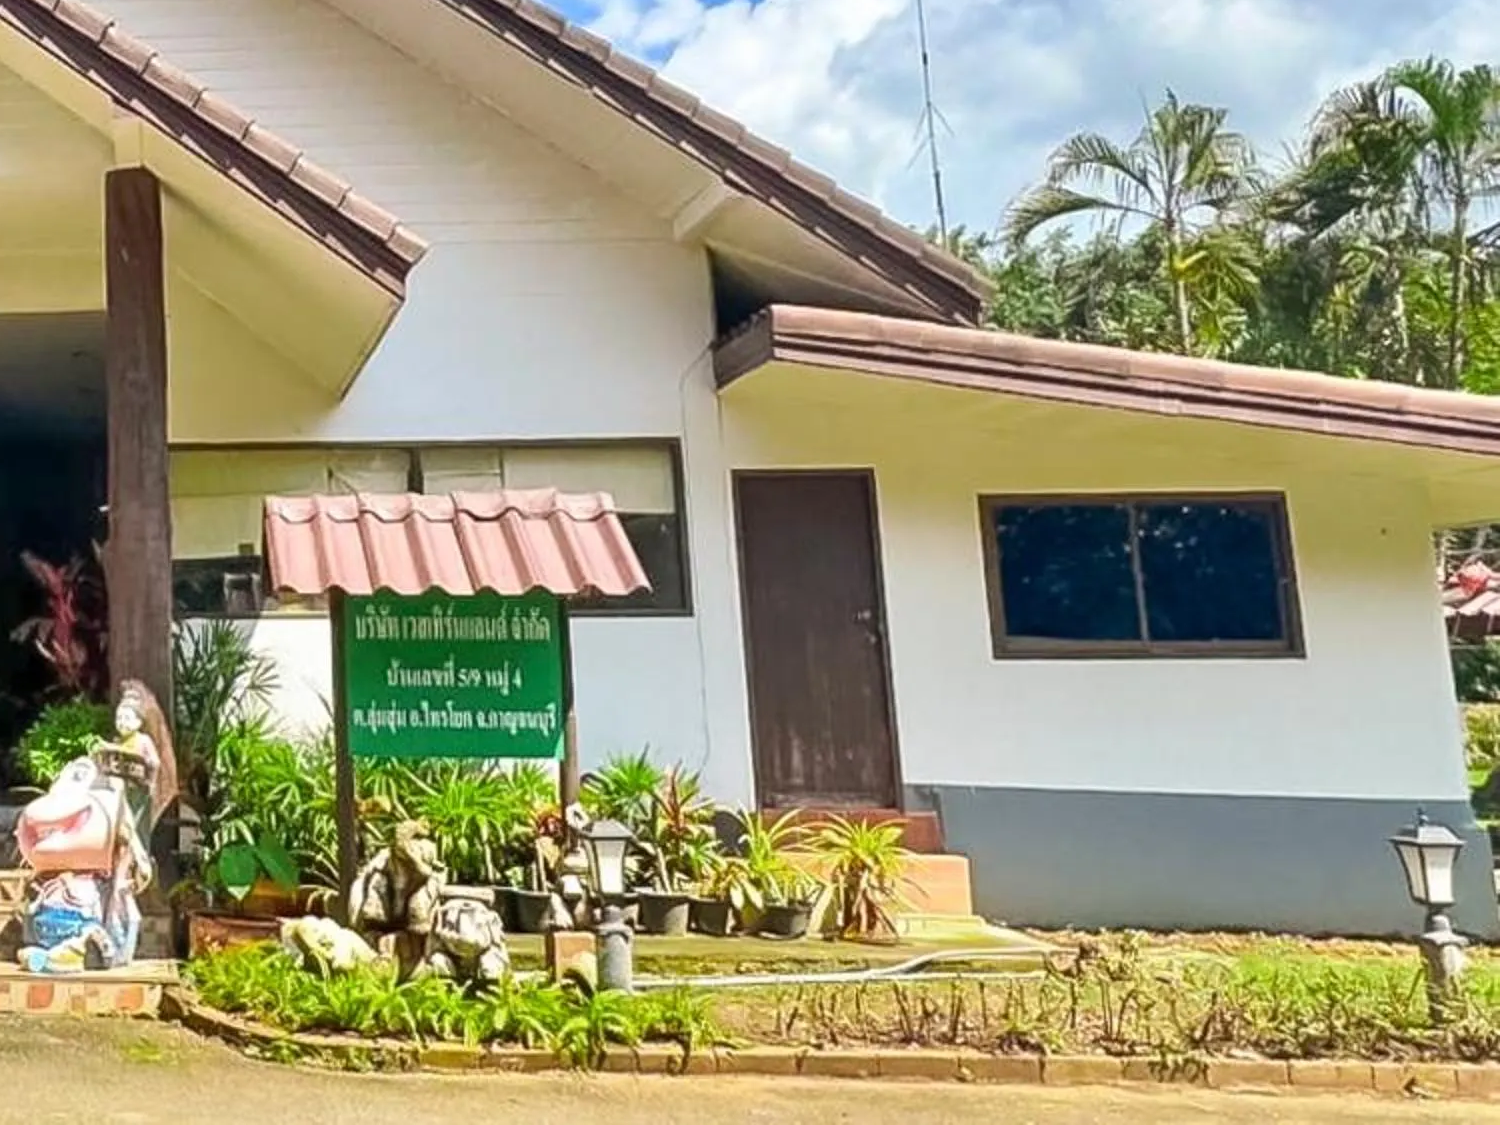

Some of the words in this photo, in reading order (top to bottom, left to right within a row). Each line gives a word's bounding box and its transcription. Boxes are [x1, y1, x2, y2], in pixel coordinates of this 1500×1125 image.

[356, 604, 399, 640] บริษัท
[511, 606, 550, 641] จำกัด
[387, 655, 455, 687] บ้านเลขที่
[484, 660, 509, 696] หมู่
[512, 667, 522, 688] 4
